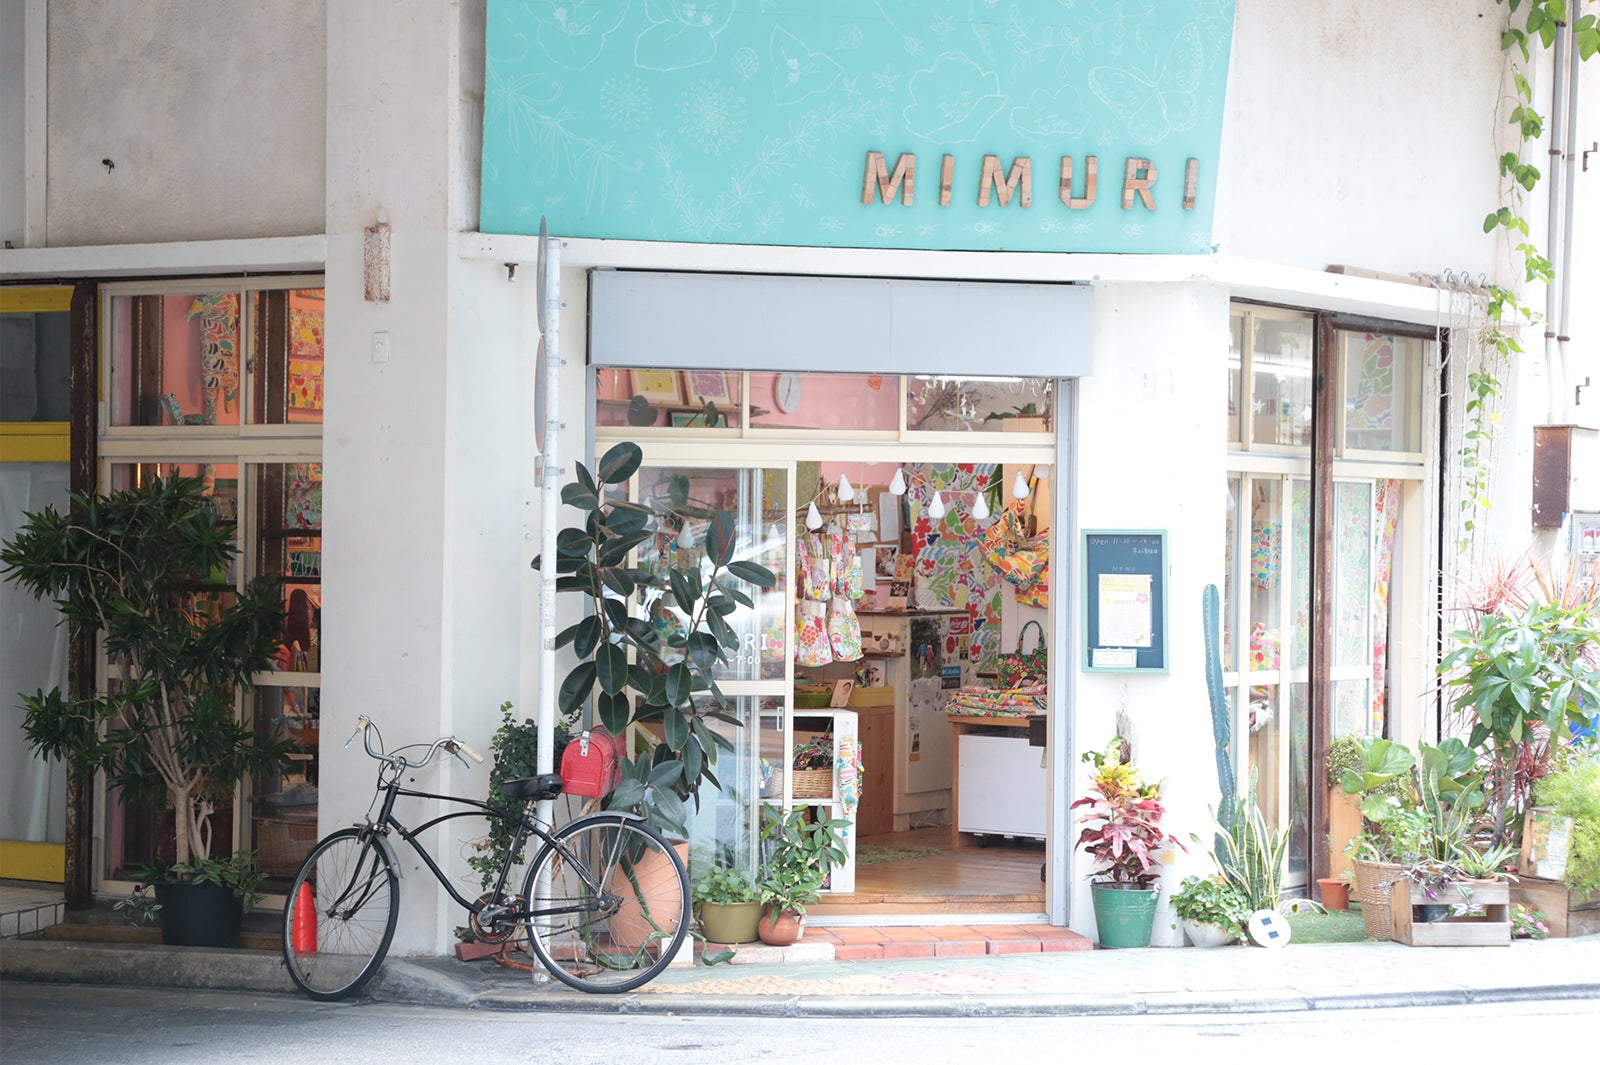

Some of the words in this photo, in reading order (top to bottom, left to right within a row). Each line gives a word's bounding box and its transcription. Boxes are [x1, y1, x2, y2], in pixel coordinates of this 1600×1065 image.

[861, 150, 1199, 210] MIMURI
[744, 633, 768, 651] RI
[1097, 652, 1131, 664] OPEN
